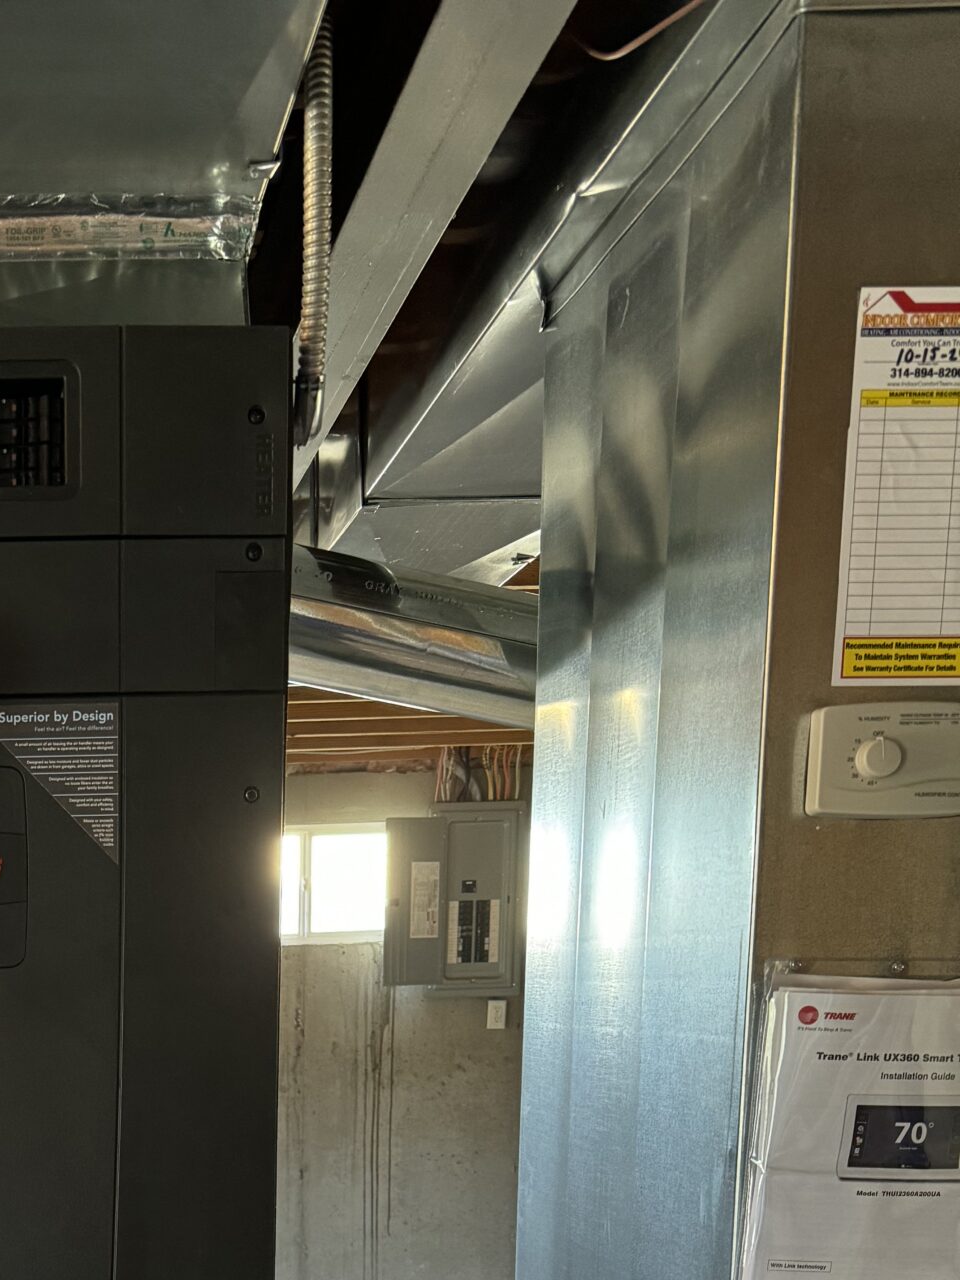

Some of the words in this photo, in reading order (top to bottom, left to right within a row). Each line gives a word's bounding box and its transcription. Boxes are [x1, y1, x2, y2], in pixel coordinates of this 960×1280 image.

[863, 314, 908, 327] INDOOR
[891, 339, 920, 347] Comfort
[896, 347, 960, 366] 10-15-2
[54, 711, 68, 724] by
[72, 710, 113, 724] Design
[856, 1053, 879, 1062] Link
[883, 1053, 920, 1062] UX360
[922, 1054, 954, 1063] Smart
[881, 1072, 928, 1081] Installation
